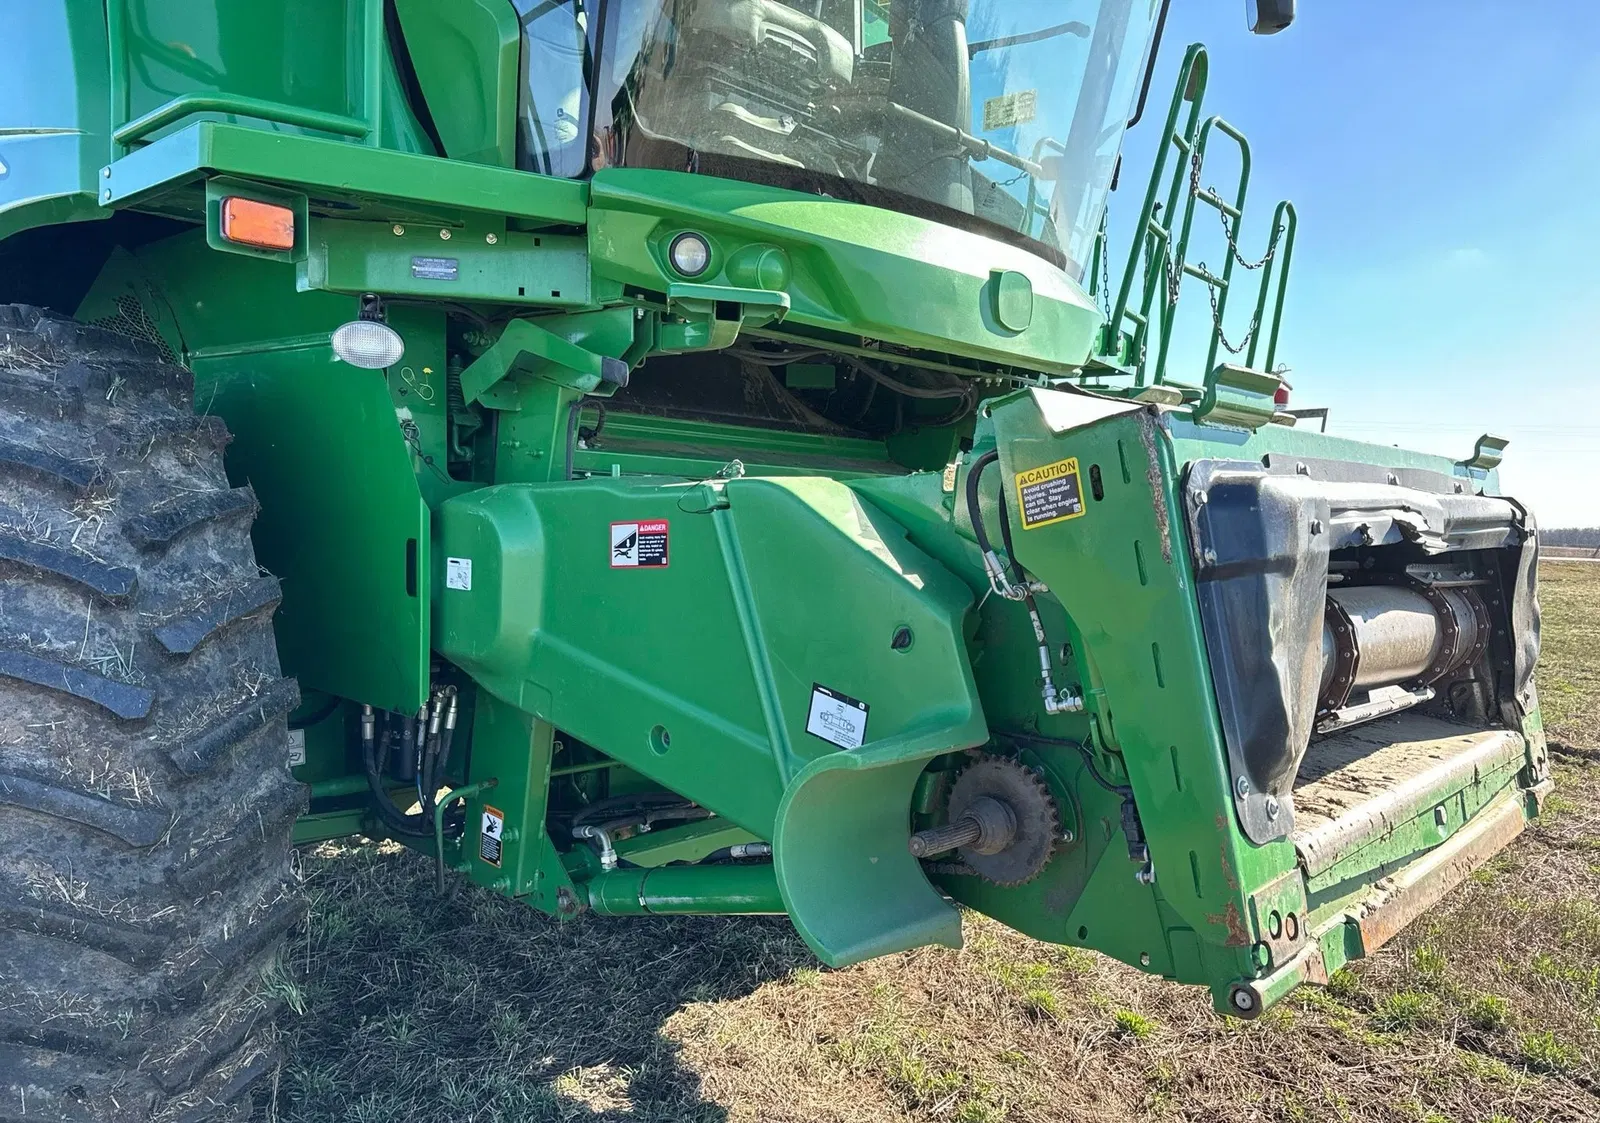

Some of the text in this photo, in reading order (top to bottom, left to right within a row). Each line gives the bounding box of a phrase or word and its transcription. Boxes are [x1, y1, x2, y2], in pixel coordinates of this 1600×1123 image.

[1027, 461, 1076, 483] CAUTION
[1023, 478, 1067, 495] Avoid crushing
[1024, 484, 1071, 502] injuries. Header
[1025, 501, 1036, 509] can
[1048, 495, 1062, 503] Stay
[1026, 497, 1078, 515] clear when engine
[644, 524, 666, 532] DANGER
